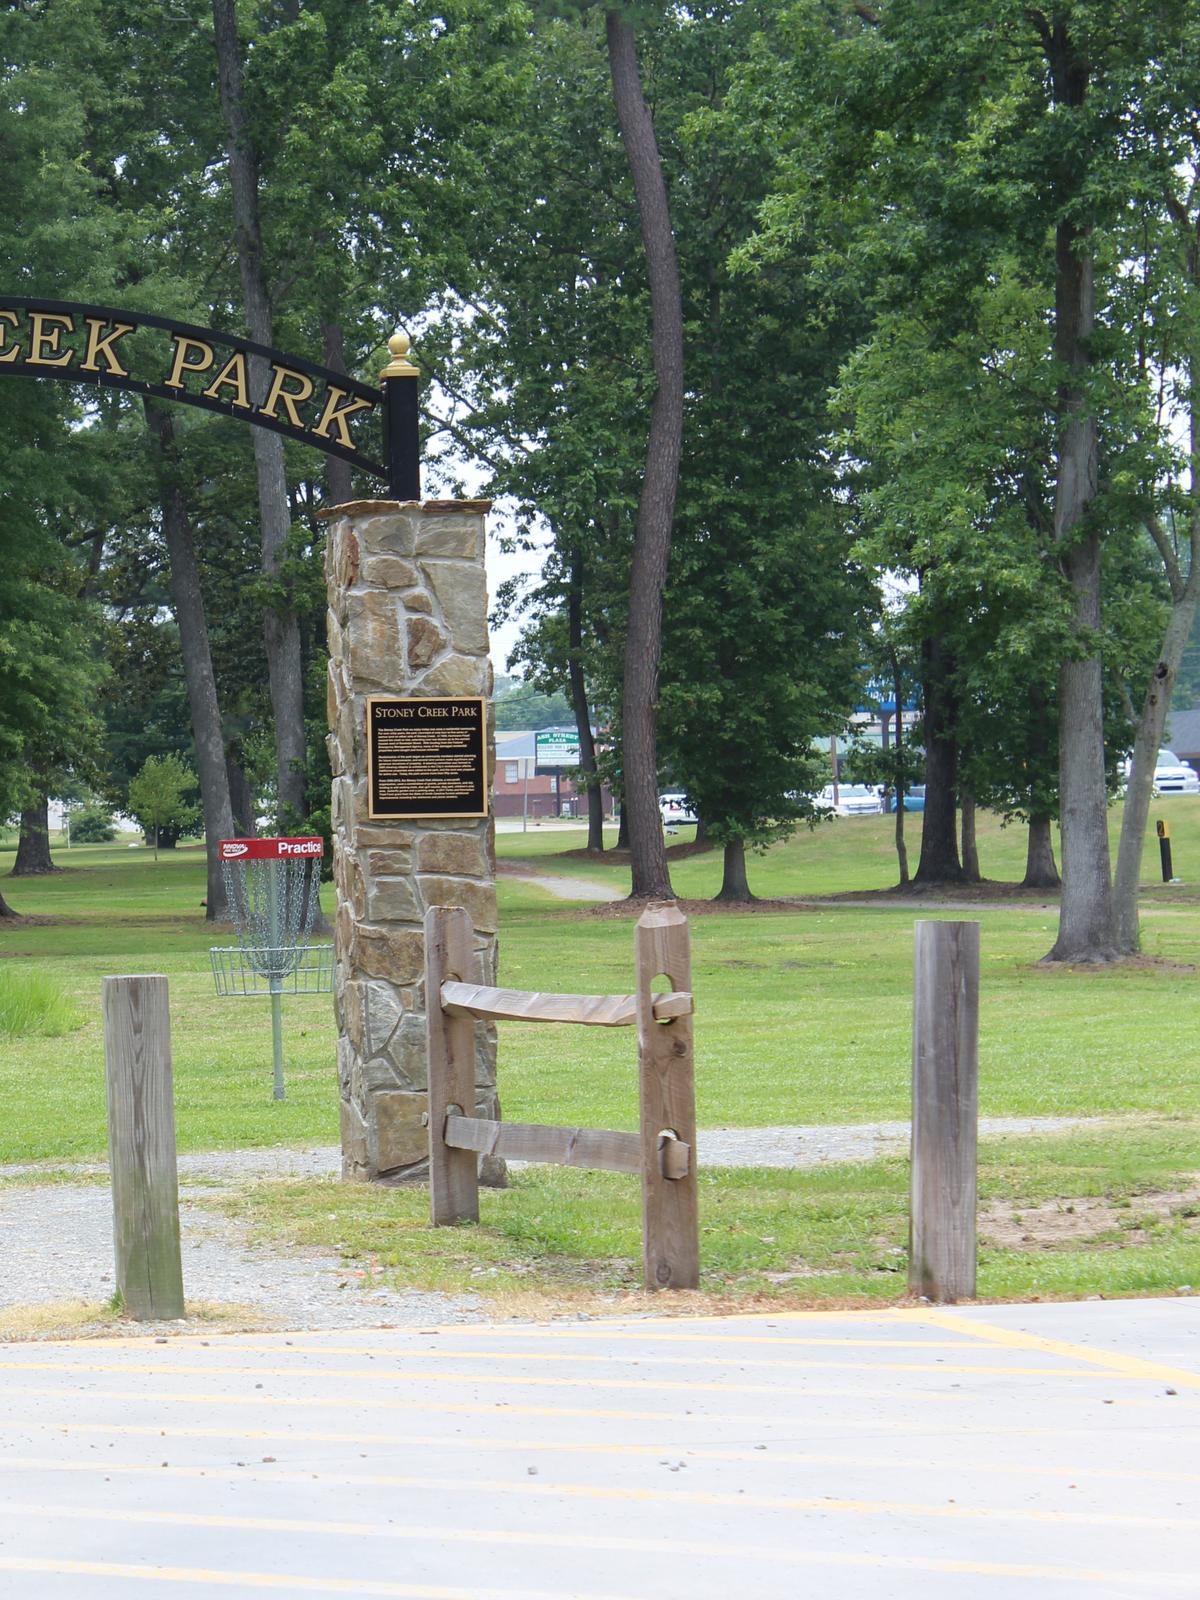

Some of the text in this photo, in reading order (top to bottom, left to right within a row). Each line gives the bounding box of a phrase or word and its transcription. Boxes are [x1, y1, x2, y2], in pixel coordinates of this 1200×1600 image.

[164, 334, 376, 451] PARK
[375, 706, 477, 718] STONEY CREEK PARK
[278, 841, 321, 854] Practice
